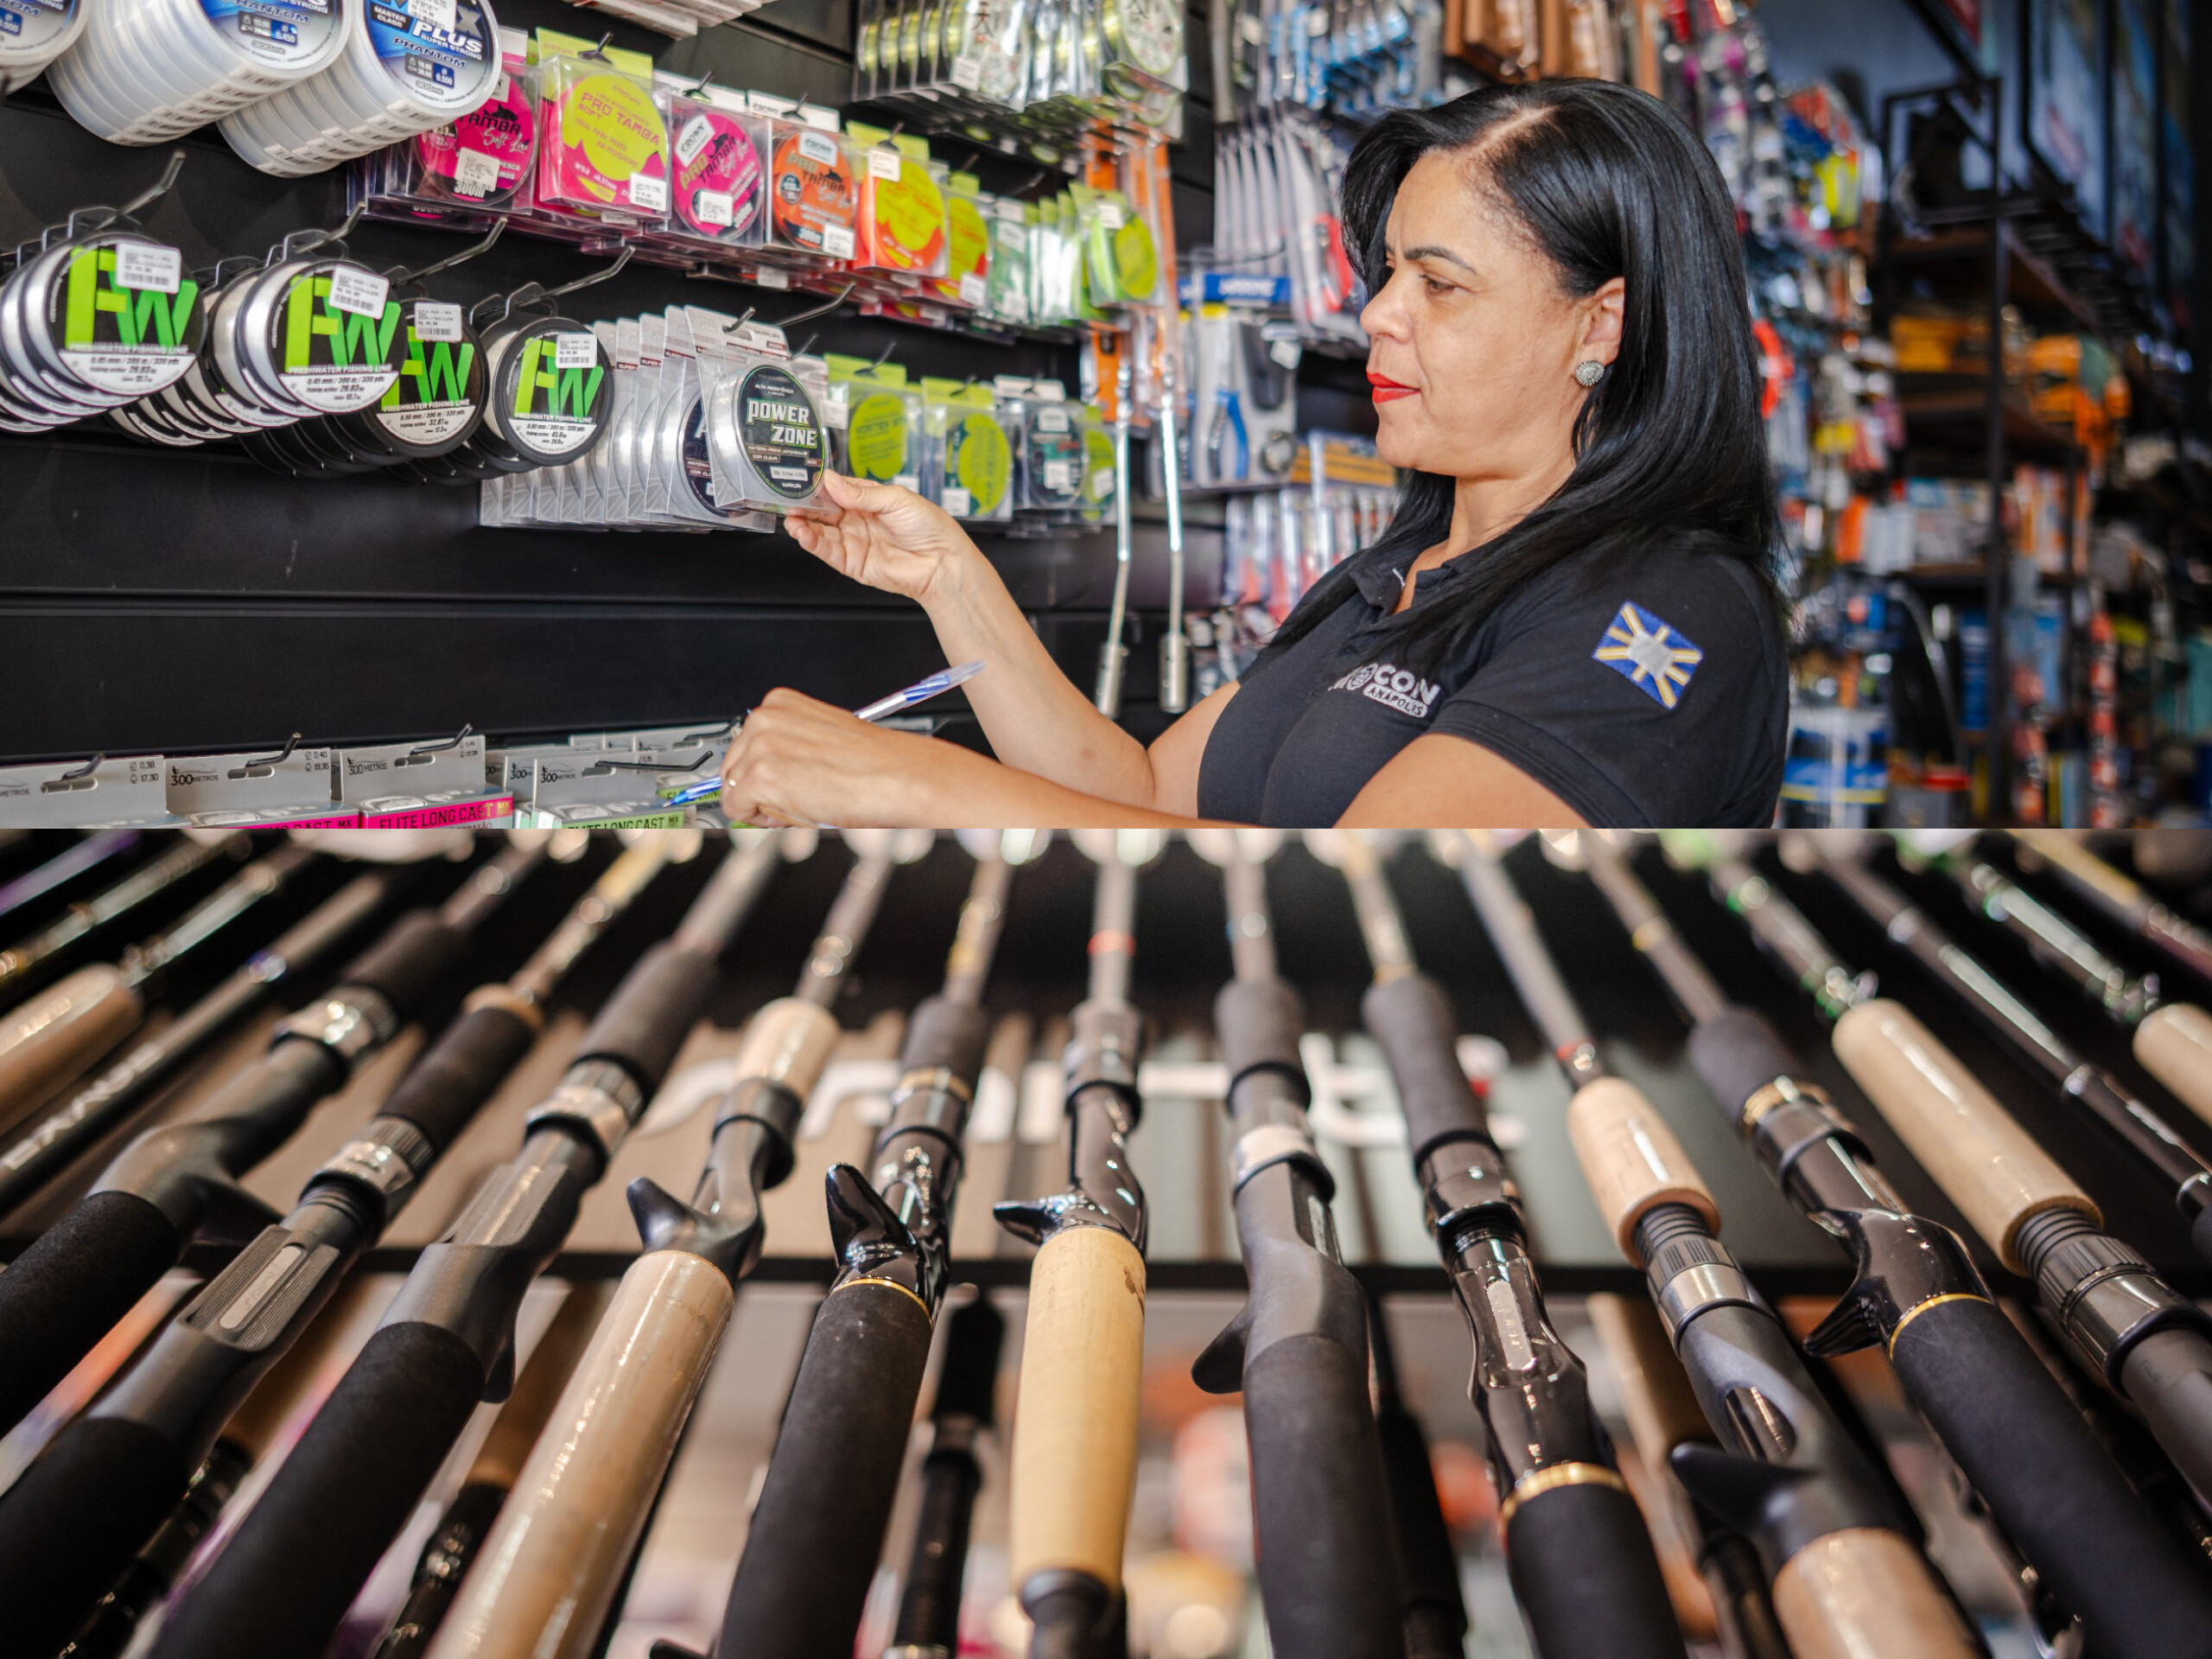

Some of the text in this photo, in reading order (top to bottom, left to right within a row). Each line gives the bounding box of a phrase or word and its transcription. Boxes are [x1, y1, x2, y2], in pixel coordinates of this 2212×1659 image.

[374, 5, 407, 22] MASTER
[377, 14, 404, 29] CLASS
[412, 20, 483, 54] PLUS
[421, 34, 483, 60] SUPER STRONG
[392, 36, 467, 69] PHANTOM
[577, 103, 602, 121] SOFT
[581, 92, 660, 147] PRO TAMBA
[483, 126, 511, 149] Soft
[681, 122, 705, 154] CROWN
[679, 152, 709, 191] PRO
[698, 135, 738, 184] TAMBA
[786, 152, 818, 173] PRO
[802, 171, 846, 194] TAMBA
[65, 245, 199, 353] FW
[285, 275, 402, 374] FW
[288, 363, 393, 374] FRESHWATER FISHING LINE
[513, 337, 604, 420] FW
[374, 376, 385, 385] yds
[383, 399, 471, 413] FRESHWATER FISHING LINE
[516, 412, 554, 421] FRESHWATER
[554, 414, 578, 423] FISHING
[747, 398, 810, 425] POWER
[771, 423, 818, 449] ZONE
[140, 761, 156, 770] 0,38
[140, 773, 159, 782] 17,30
[171, 774, 194, 786] 300
[541, 772, 557, 783] 300
[379, 815, 418, 829] ELITE
[422, 809, 456, 827] LONG
[459, 803, 493, 821] CAST
[635, 817, 665, 829] CAST
